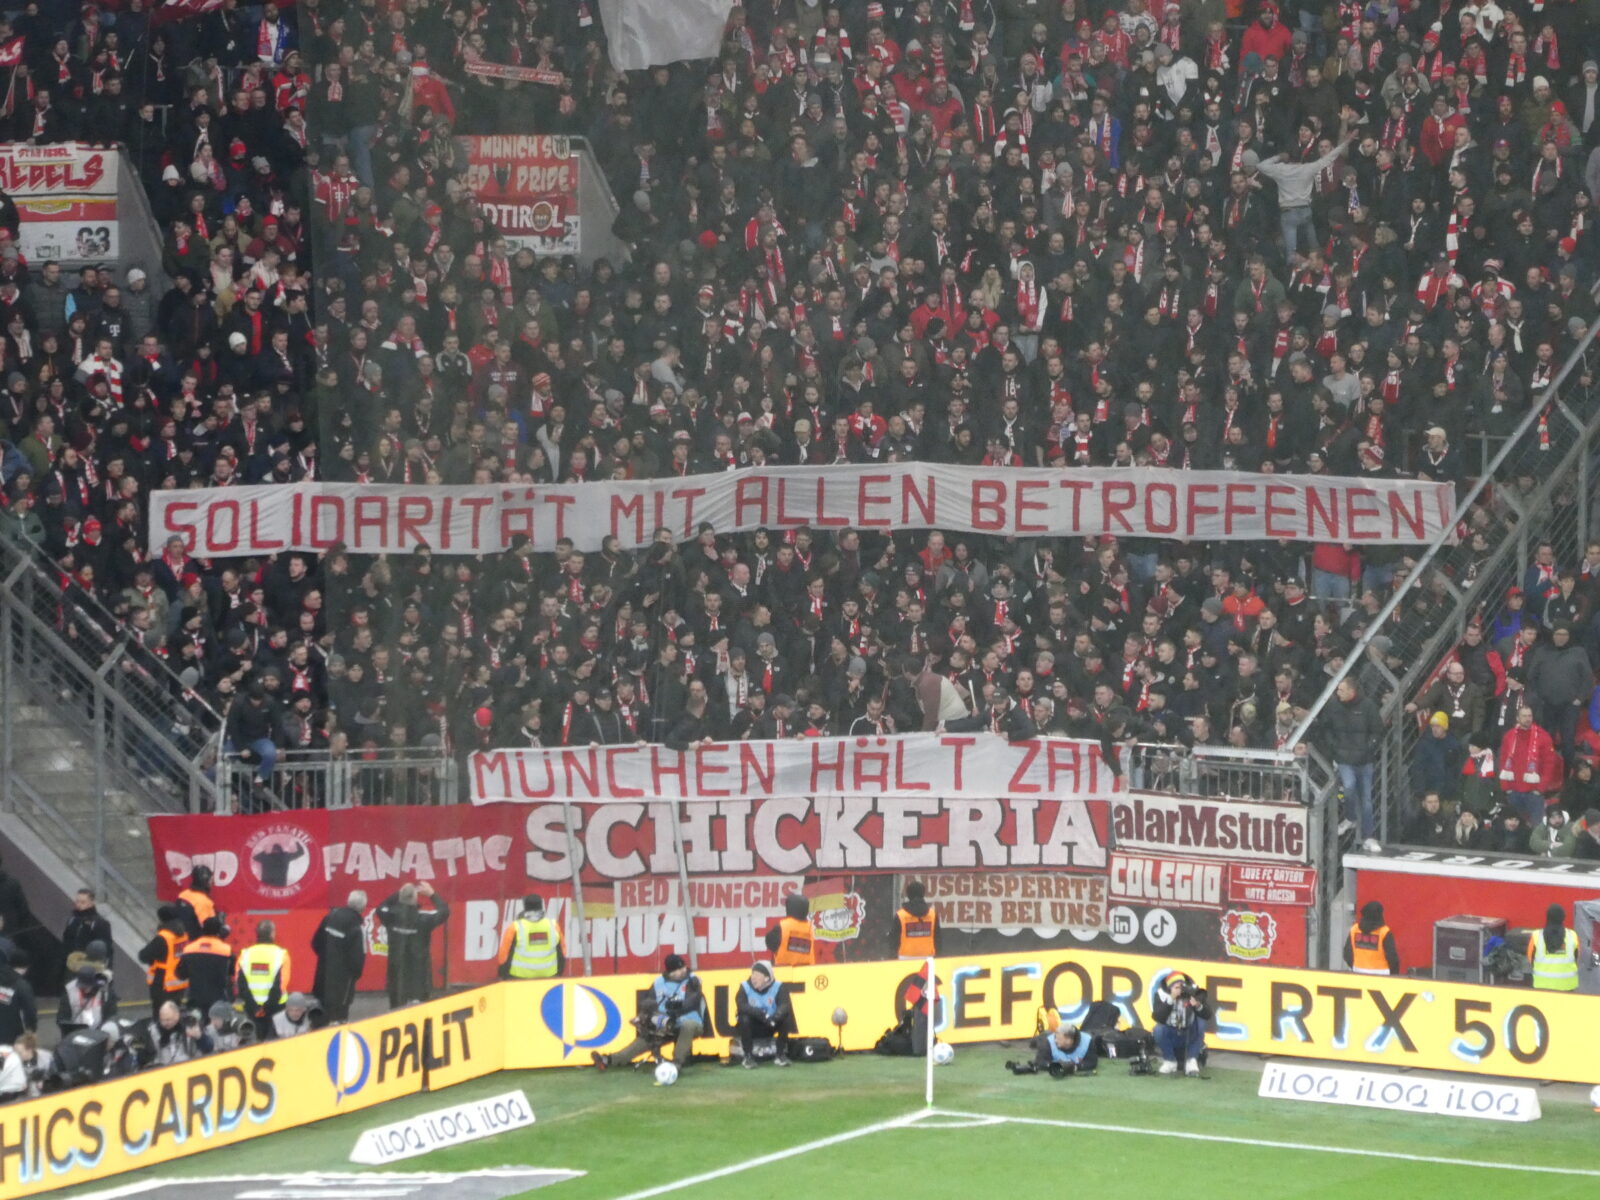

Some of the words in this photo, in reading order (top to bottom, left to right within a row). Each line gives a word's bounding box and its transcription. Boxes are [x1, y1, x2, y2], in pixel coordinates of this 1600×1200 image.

[517, 165, 570, 193] PRIDE
[164, 488, 576, 553] SOLIDARITÄT
[611, 488, 706, 544] MIT
[735, 475, 936, 527] ALLEN
[473, 743, 775, 799] MÜNCHEN
[810, 737, 976, 793] HÄLT
[526, 797, 1107, 882] SCHICKERIA
[1113, 799, 1304, 856] alarMstufe
[322, 834, 513, 882] FANATIC
[1110, 856, 1223, 904] COLEGIO
[1240, 867, 1261, 880] LOVE
[620, 881, 668, 908] RED
[1001, 901, 1041, 924] BEI
[1051, 902, 1101, 926] UNS
[1270, 981, 1418, 1054] RTX
[1450, 998, 1549, 1065] 50
[0, 1100, 104, 1183] HICS
[119, 1057, 276, 1156] CARDS
